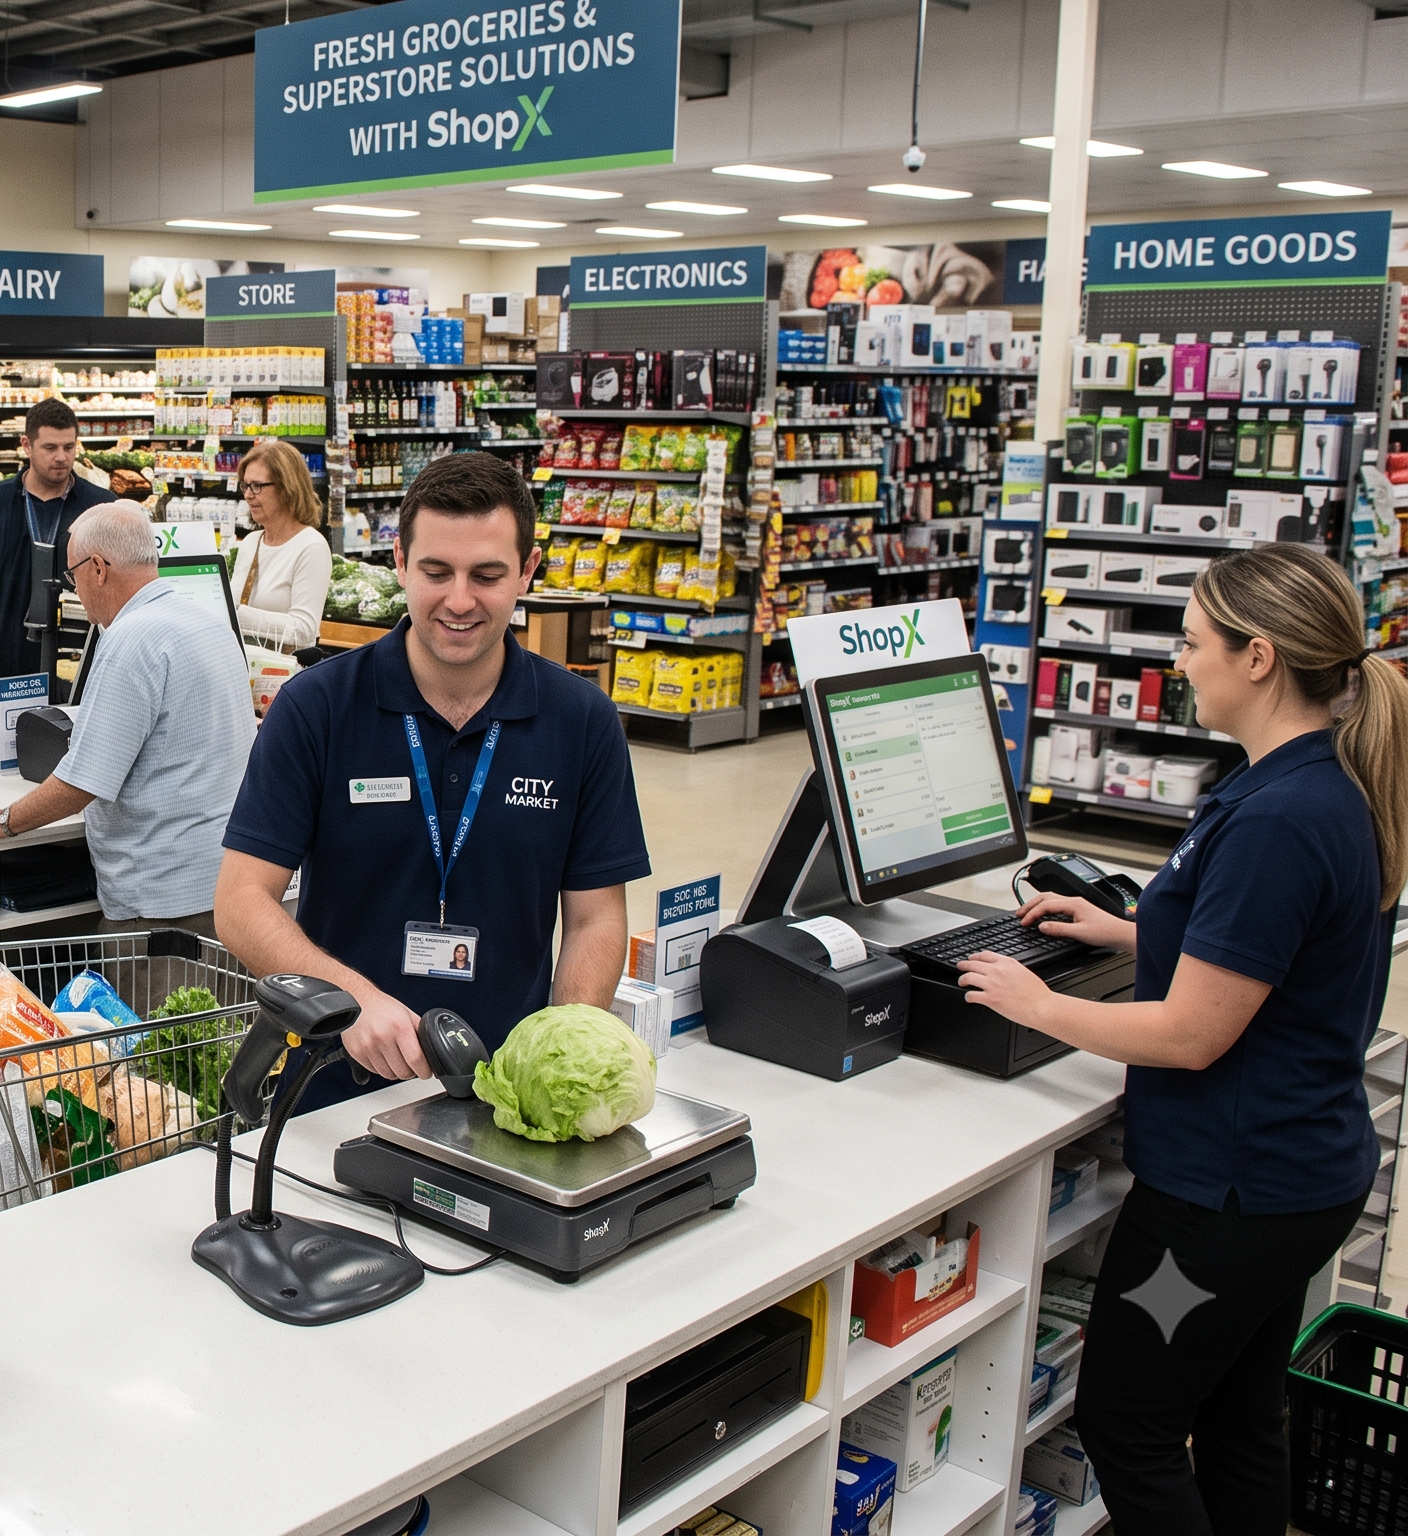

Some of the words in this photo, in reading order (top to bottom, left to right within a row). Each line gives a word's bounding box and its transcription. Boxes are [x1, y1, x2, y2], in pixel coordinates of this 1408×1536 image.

[314, 30, 394, 71] FRESH
[403, 1, 565, 56] GROCERIES
[573, 0, 597, 28] &
[283, 61, 452, 114] SUPERSTORE
[459, 32, 635, 88] SOLUTIONS
[350, 120, 417, 156] WITH
[427, 86, 554, 151] ShopX
[1115, 237, 1215, 270] HOME
[1225, 231, 1357, 266] GOODS
[239, 284, 295, 306] STORE
[585, 261, 747, 292] ELECTRONICS
[839, 609, 925, 658] ShopX
[505, 793, 558, 810] MARKET
[511, 777, 554, 796] CITY
